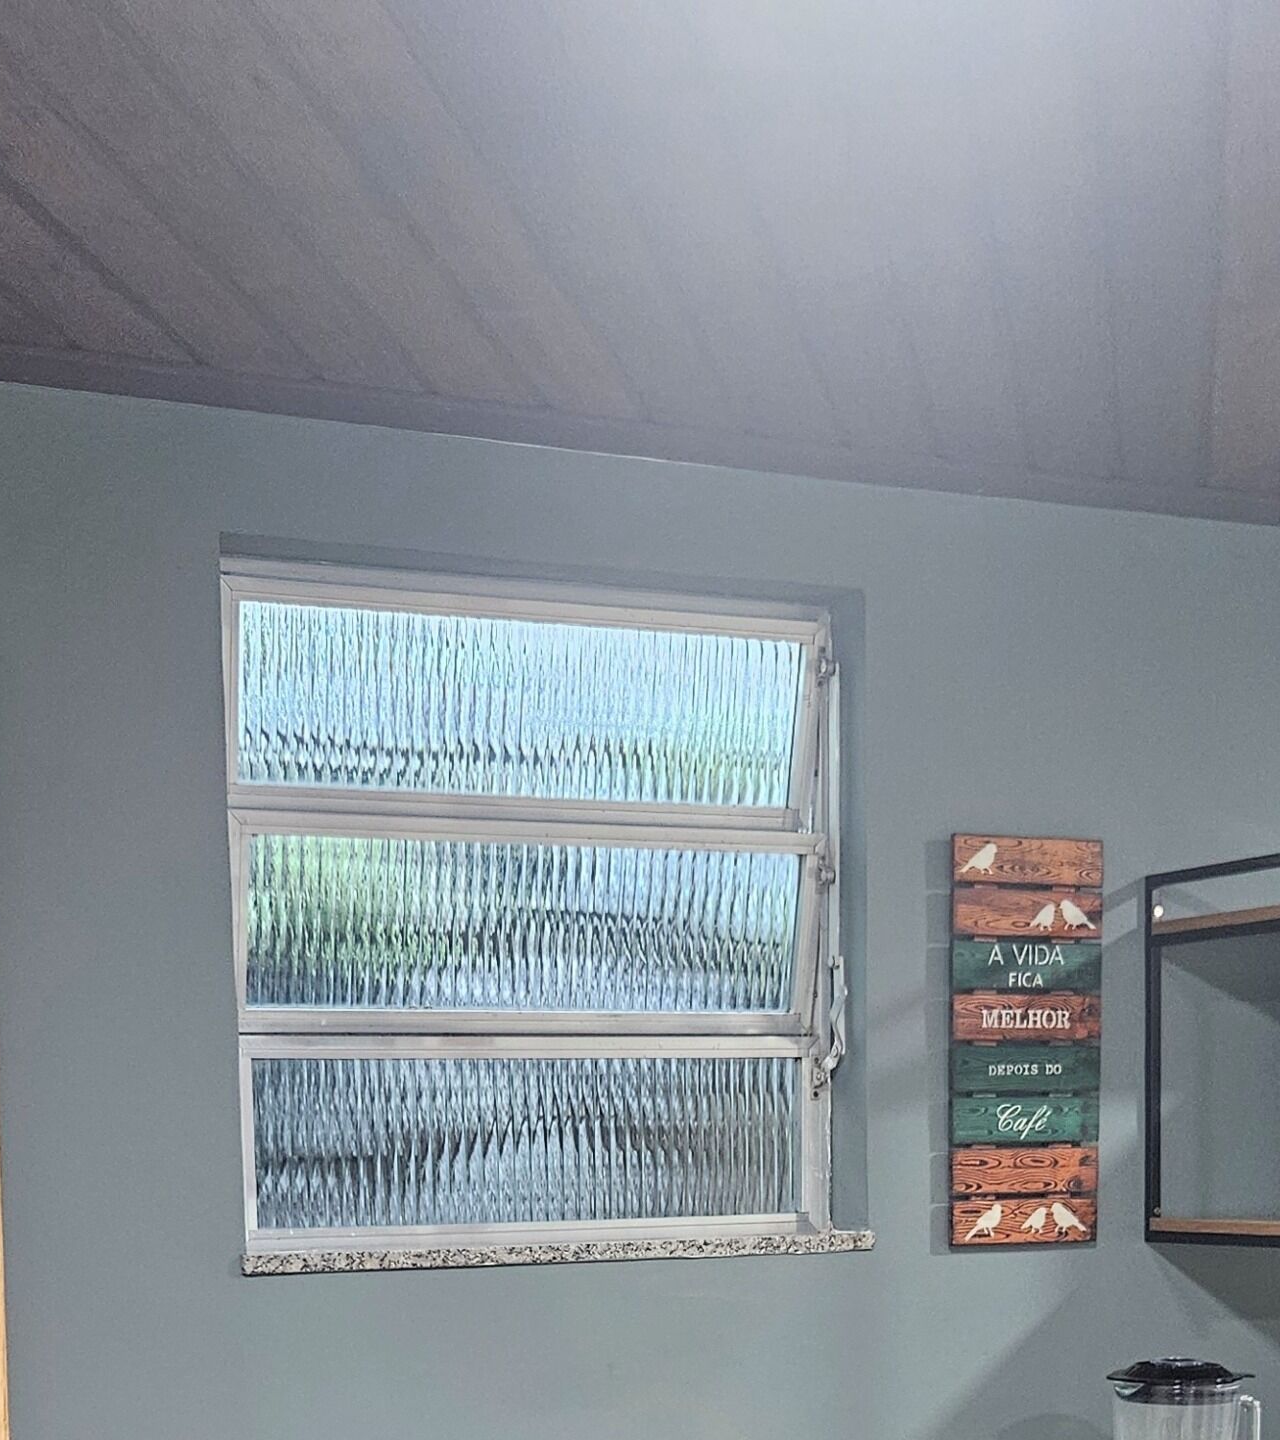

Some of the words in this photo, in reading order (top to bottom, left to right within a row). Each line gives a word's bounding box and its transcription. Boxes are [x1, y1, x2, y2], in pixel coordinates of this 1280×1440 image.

[988, 944, 1004, 966] A
[1012, 943, 1065, 966] VIDA
[1008, 971, 1043, 988] FICA
[981, 1008, 1071, 1030] MELHOR
[988, 1063, 1039, 1077] DEPOIS
[1045, 1063, 1062, 1075] DO
[996, 1104, 1053, 1140] Café
